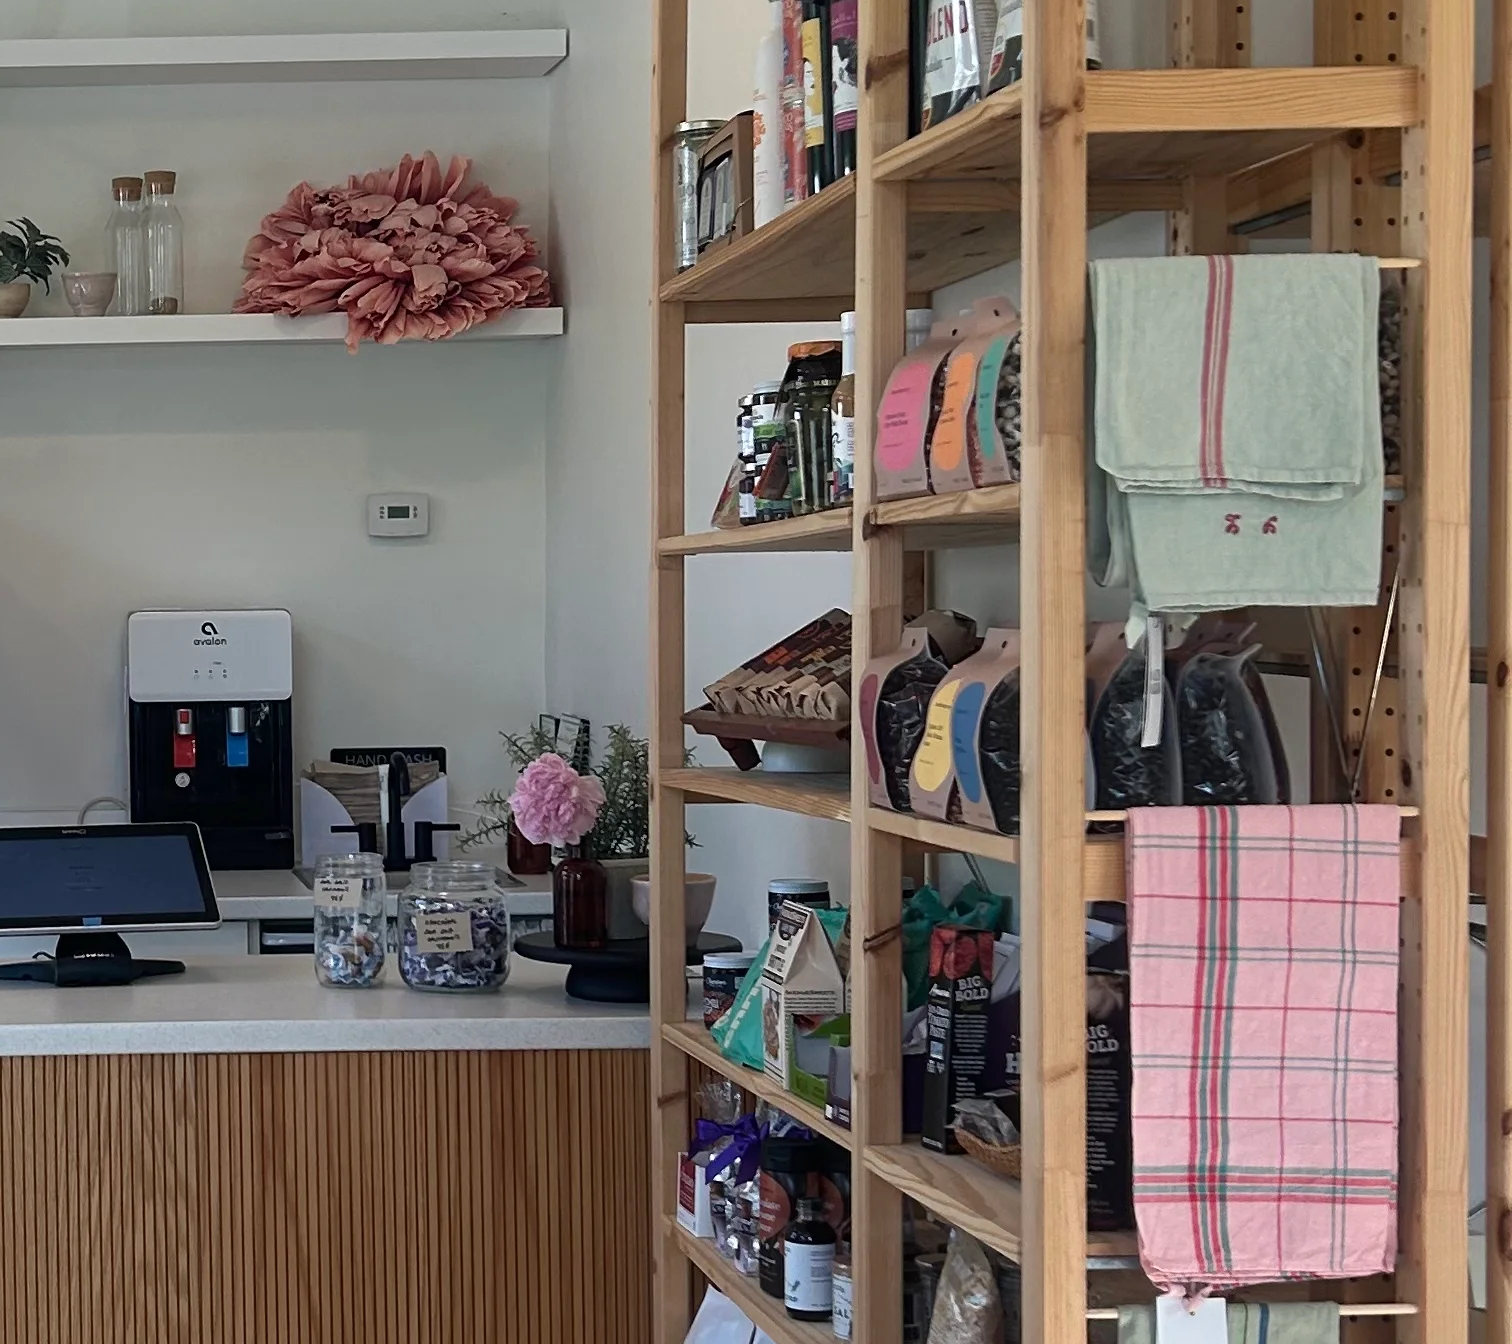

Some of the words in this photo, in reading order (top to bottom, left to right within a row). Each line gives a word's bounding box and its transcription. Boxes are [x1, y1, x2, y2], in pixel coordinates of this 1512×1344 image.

[194, 637, 227, 645] avalon
[345, 754, 386, 764] HAND
[403, 754, 432, 763] ASH
[958, 975, 982, 991] BIG
[955, 988, 989, 1002] BOLD
[1087, 1024, 1109, 1040] IG
[1087, 1039, 1120, 1053] OLD
